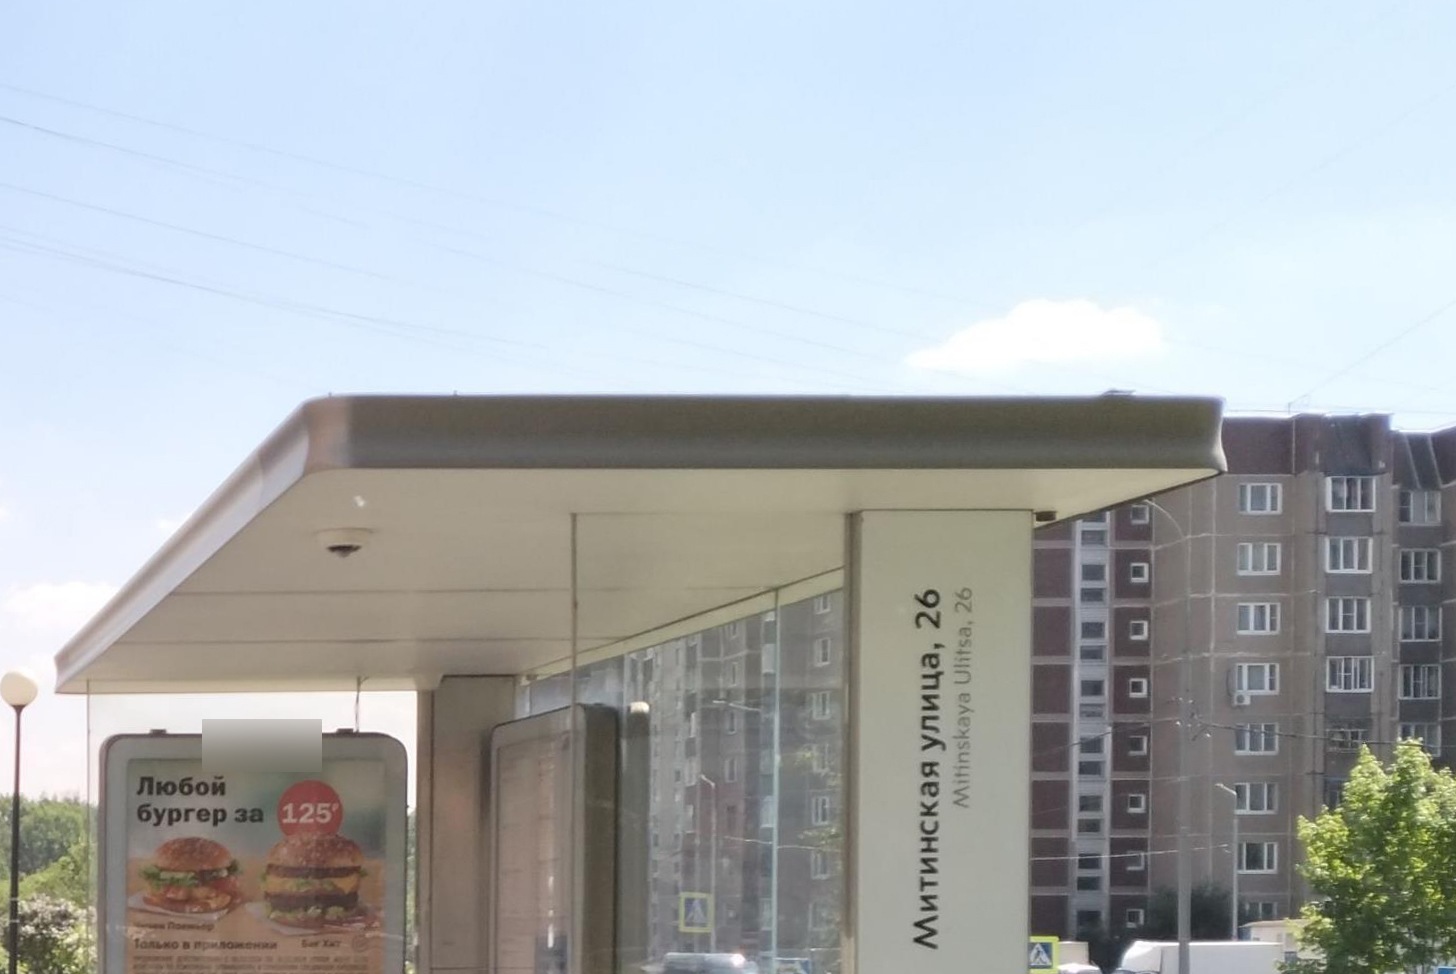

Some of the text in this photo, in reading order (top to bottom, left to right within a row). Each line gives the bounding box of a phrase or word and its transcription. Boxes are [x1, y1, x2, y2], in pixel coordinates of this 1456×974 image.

[952, 587, 975, 809] Mitinskaya Ulitsa, 26
[912, 588, 947, 950] Митинская улица, 26
[136, 775, 227, 796] Любой
[136, 803, 264, 827] бургер за
[134, 938, 179, 950] Только
[182, 941, 191, 950] в
